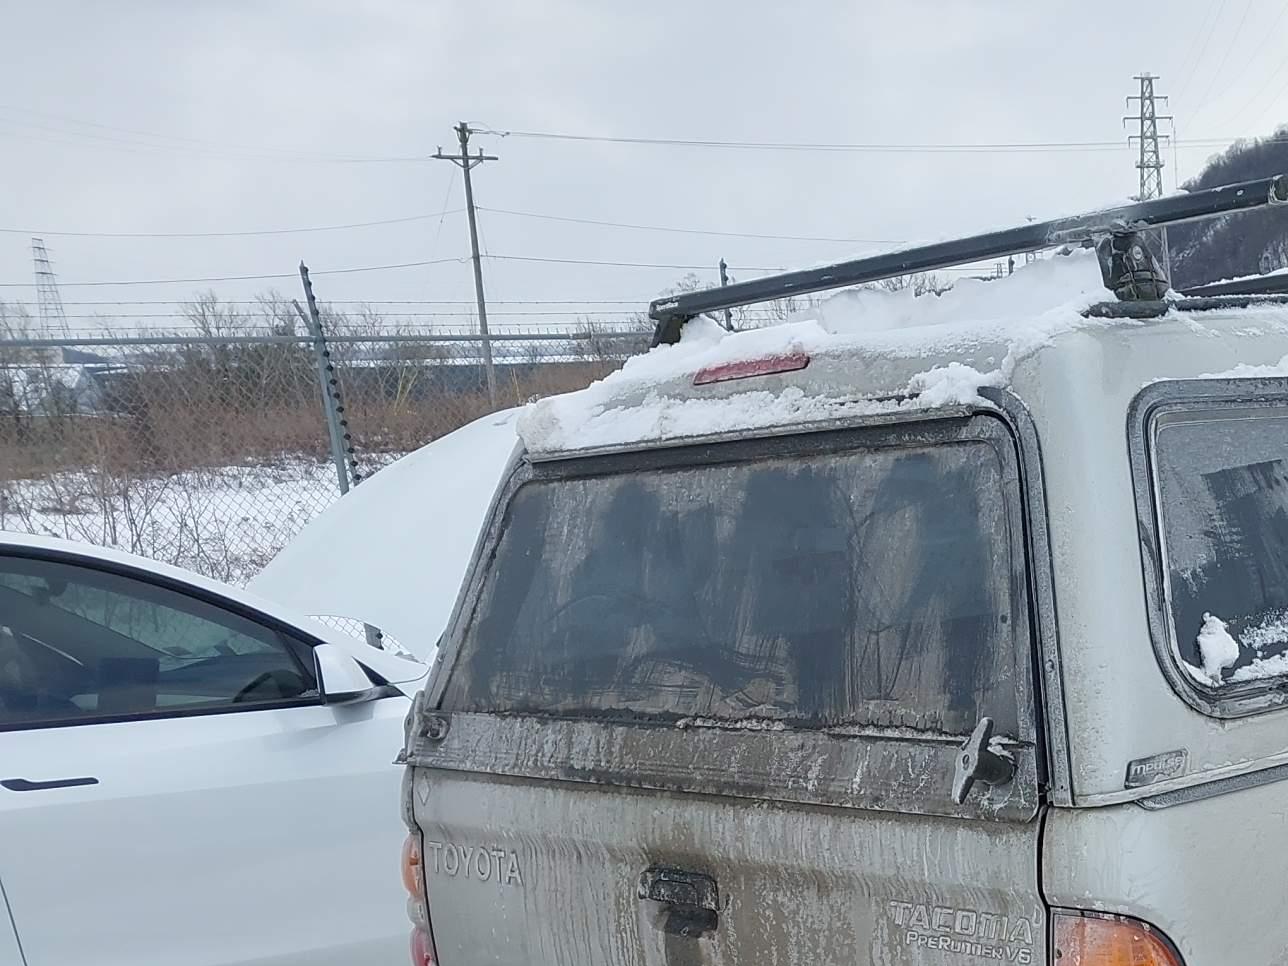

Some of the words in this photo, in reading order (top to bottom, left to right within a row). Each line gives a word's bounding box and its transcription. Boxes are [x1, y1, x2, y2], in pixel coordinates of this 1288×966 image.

[428, 841, 523, 886] TOYOTA
[890, 901, 1033, 945] TACOMA
[1006, 946, 1032, 965] V6
